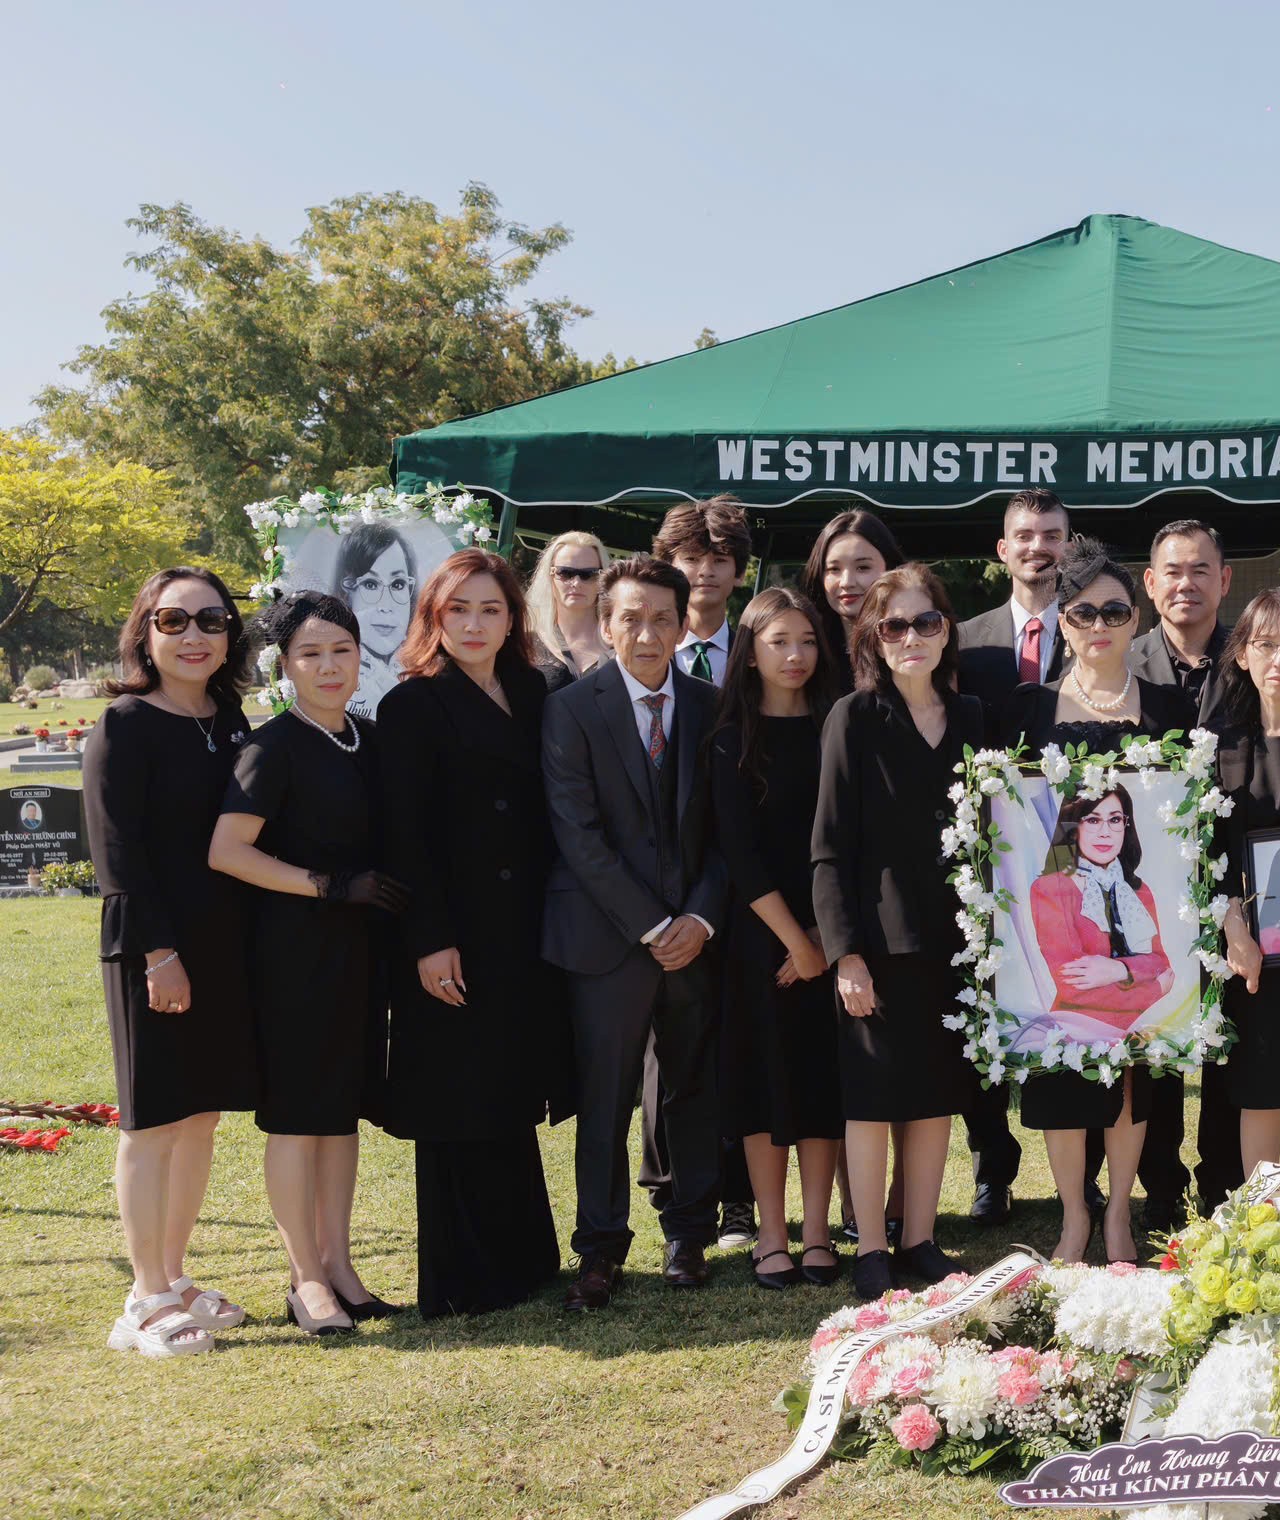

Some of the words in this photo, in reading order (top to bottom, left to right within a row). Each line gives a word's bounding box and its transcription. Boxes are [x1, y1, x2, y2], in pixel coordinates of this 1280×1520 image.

[717, 439, 1058, 483] WESTMINSTER
[803, 1423, 828, 1453] CA
[827, 1338, 870, 1385] MINH
[1022, 1482, 1118, 1501] THÀNH
[1124, 1474, 1190, 1495] KÍNH
[1195, 1467, 1270, 1489] PHÂN
[1069, 1463, 1111, 1484] Hai
[1118, 1454, 1151, 1476] Em
[1159, 1448, 1230, 1471] Hoang
